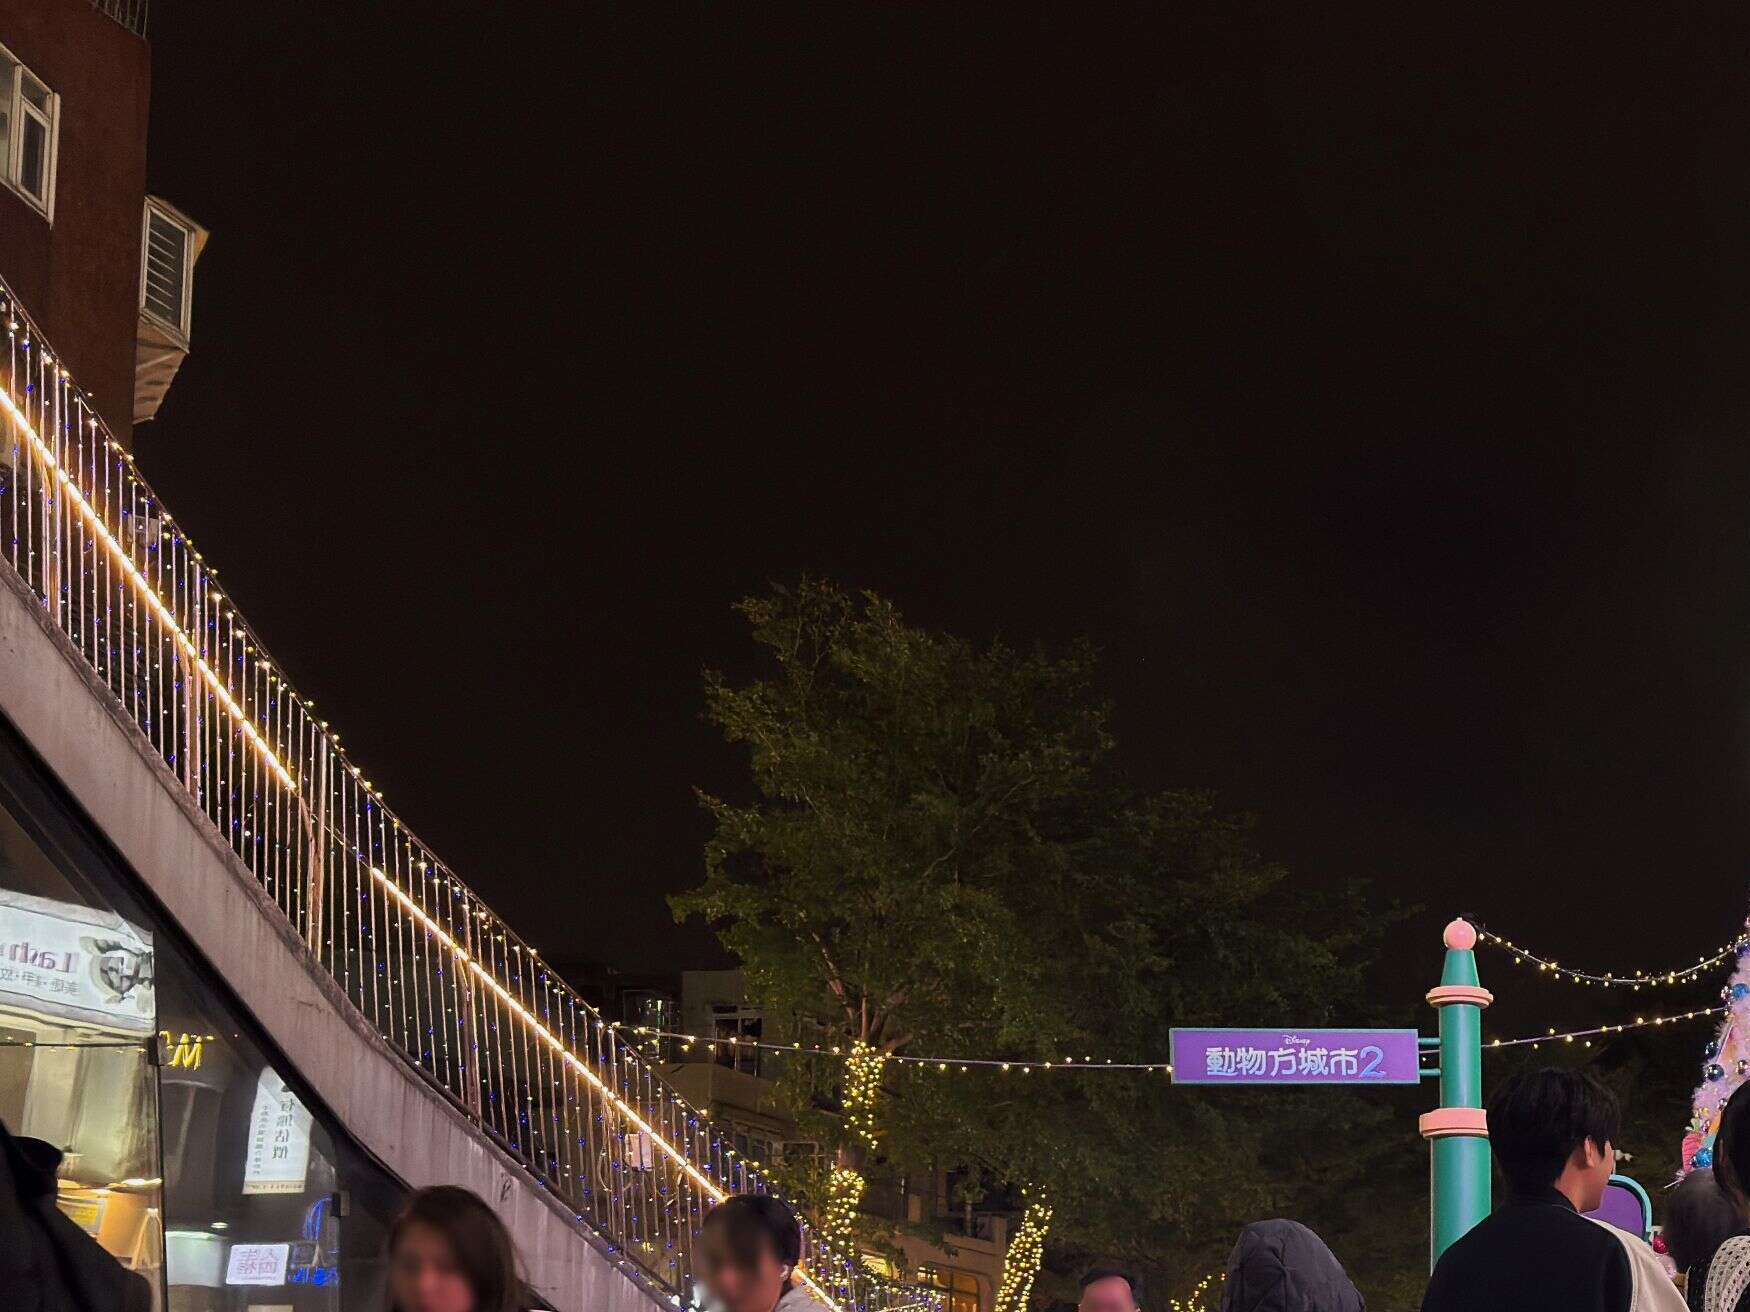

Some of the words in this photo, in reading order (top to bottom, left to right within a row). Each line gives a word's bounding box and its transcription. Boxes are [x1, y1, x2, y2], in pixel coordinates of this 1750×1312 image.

[1205, 1045, 1387, 1079] 動物方城市2
